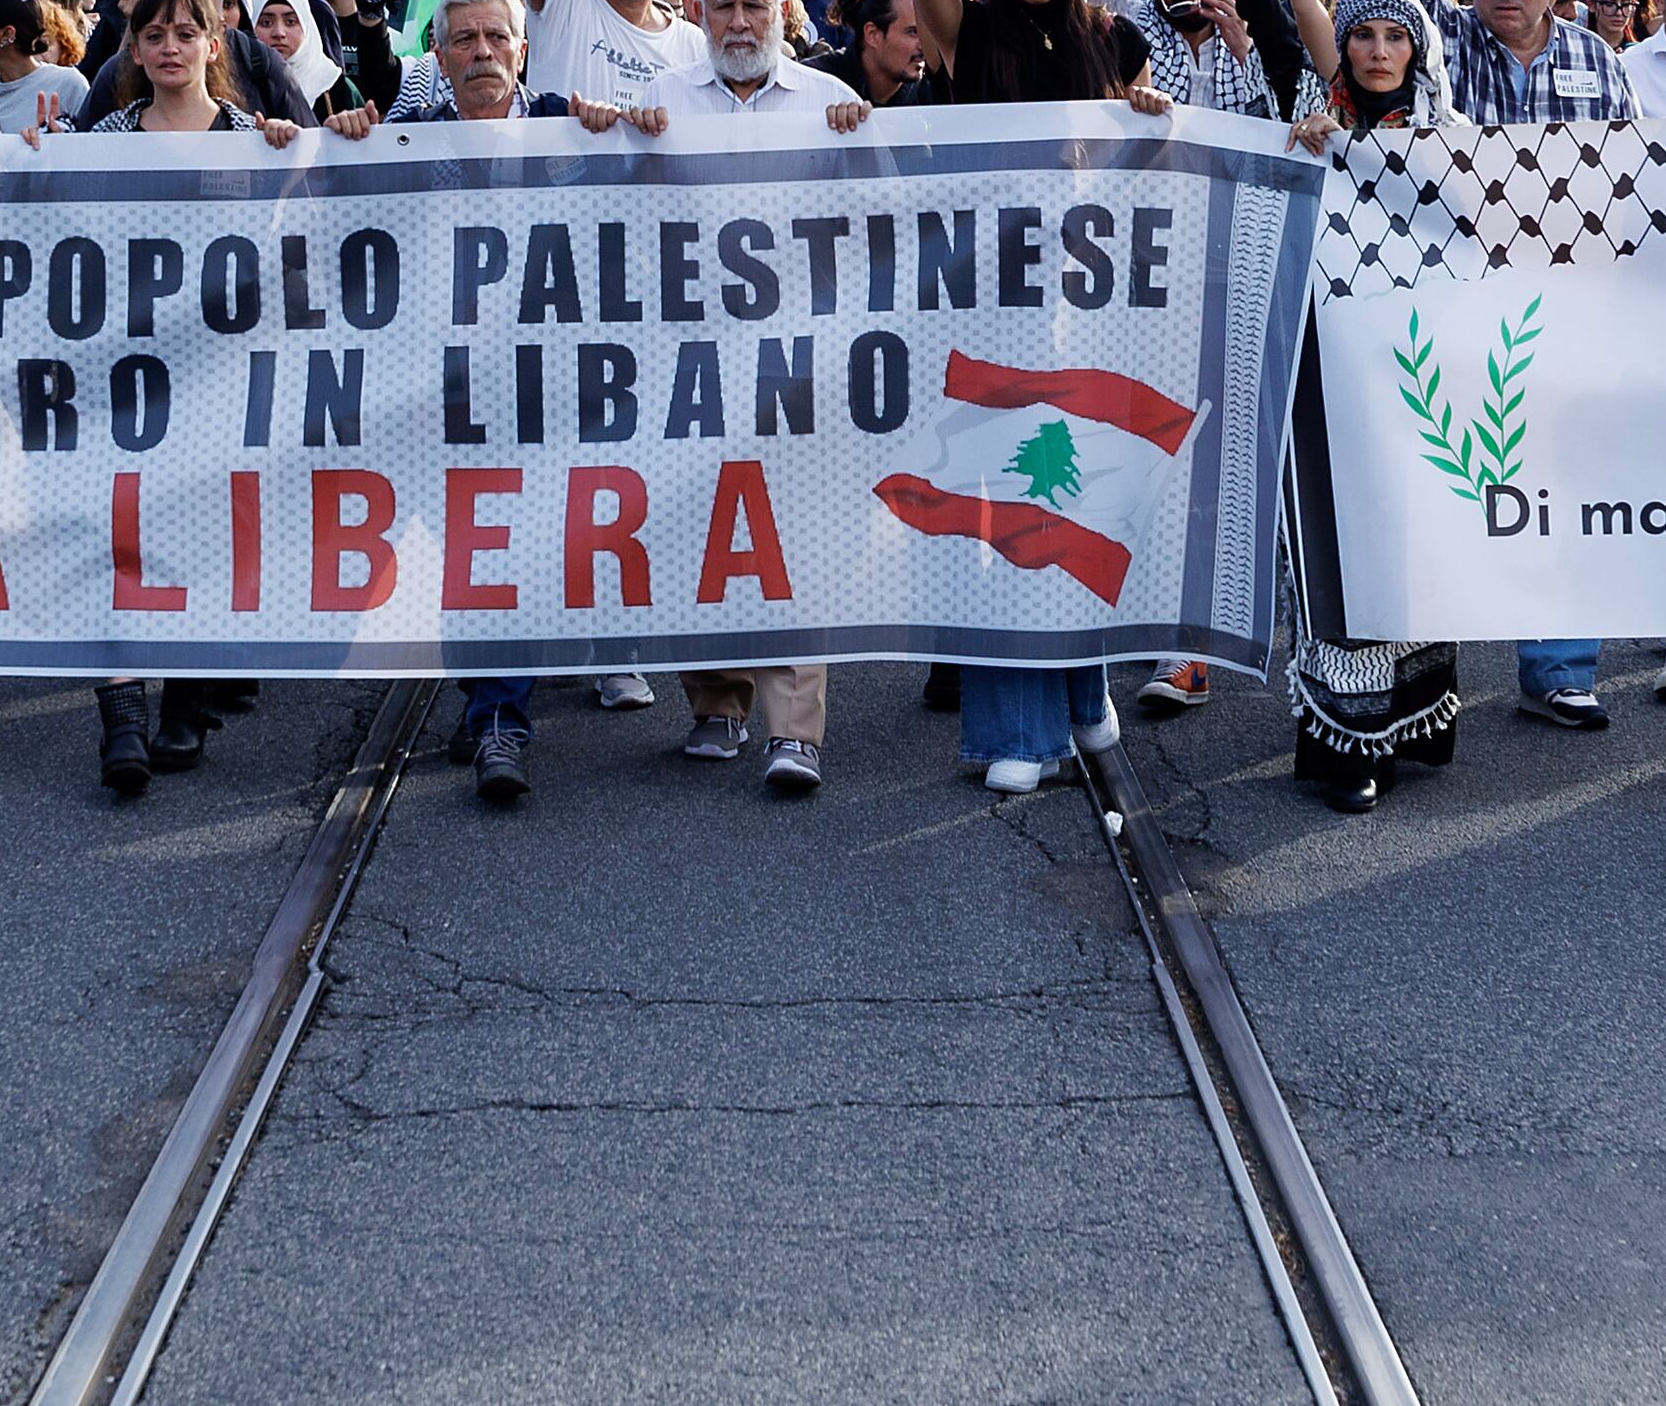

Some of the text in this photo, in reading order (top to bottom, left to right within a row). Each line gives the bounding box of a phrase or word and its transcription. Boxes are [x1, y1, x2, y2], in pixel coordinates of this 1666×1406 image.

[1555, 74, 1573, 83] FREE
[1557, 84, 1598, 94] PALESTINE
[451, 203, 1174, 327] PALESTINESE
[243, 346, 365, 448] IN
[442, 330, 911, 445] LIBANO
[112, 460, 794, 612] LIBERA
[1485, 483, 1550, 537] Di
